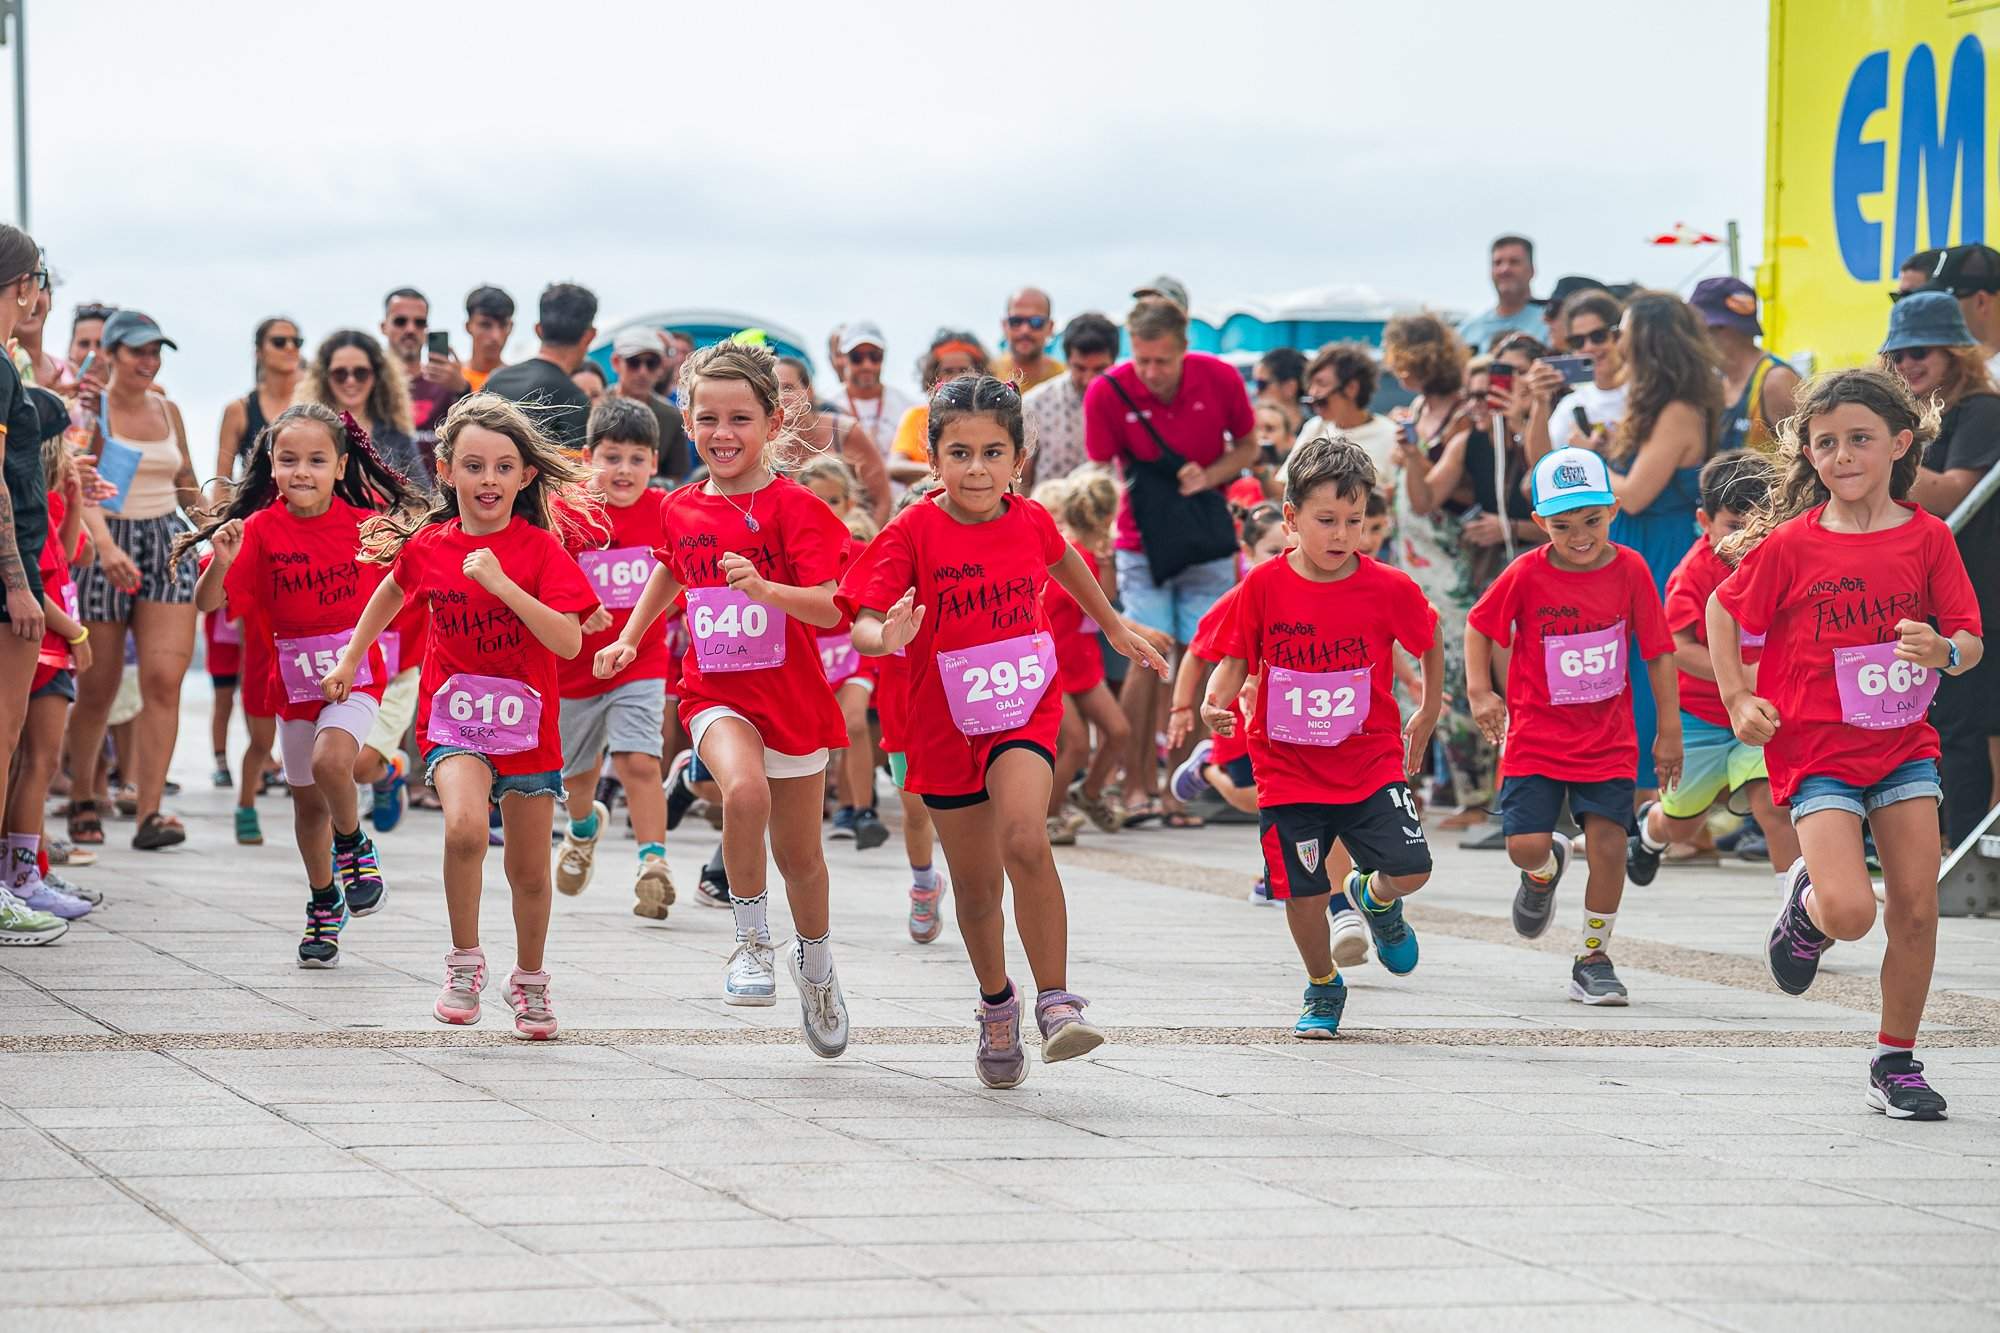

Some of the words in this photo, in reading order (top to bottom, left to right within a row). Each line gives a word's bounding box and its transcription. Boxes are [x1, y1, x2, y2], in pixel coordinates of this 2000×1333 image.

[1832, 33, 1999, 283] EM
[271, 561, 361, 600] FAMARA
[593, 559, 649, 587] 160
[1807, 577, 1867, 598] LANZAROTE
[934, 575, 1036, 633] FAMARA
[1811, 591, 1921, 642] FAMARA
[694, 605, 768, 639] 640
[294, 643, 350, 677] 15
[703, 640, 748, 656] LOLA
[1268, 635, 1370, 671] FAMARA
[1560, 639, 1619, 677] 657
[962, 655, 1045, 703] 295
[450, 691, 524, 726] 610
[996, 697, 1025, 711] GALA
[1285, 687, 1356, 718] 132
[1881, 695, 1919, 714] LANI
[459, 726, 499, 739] BERA
[1307, 720, 1331, 729] NICO
